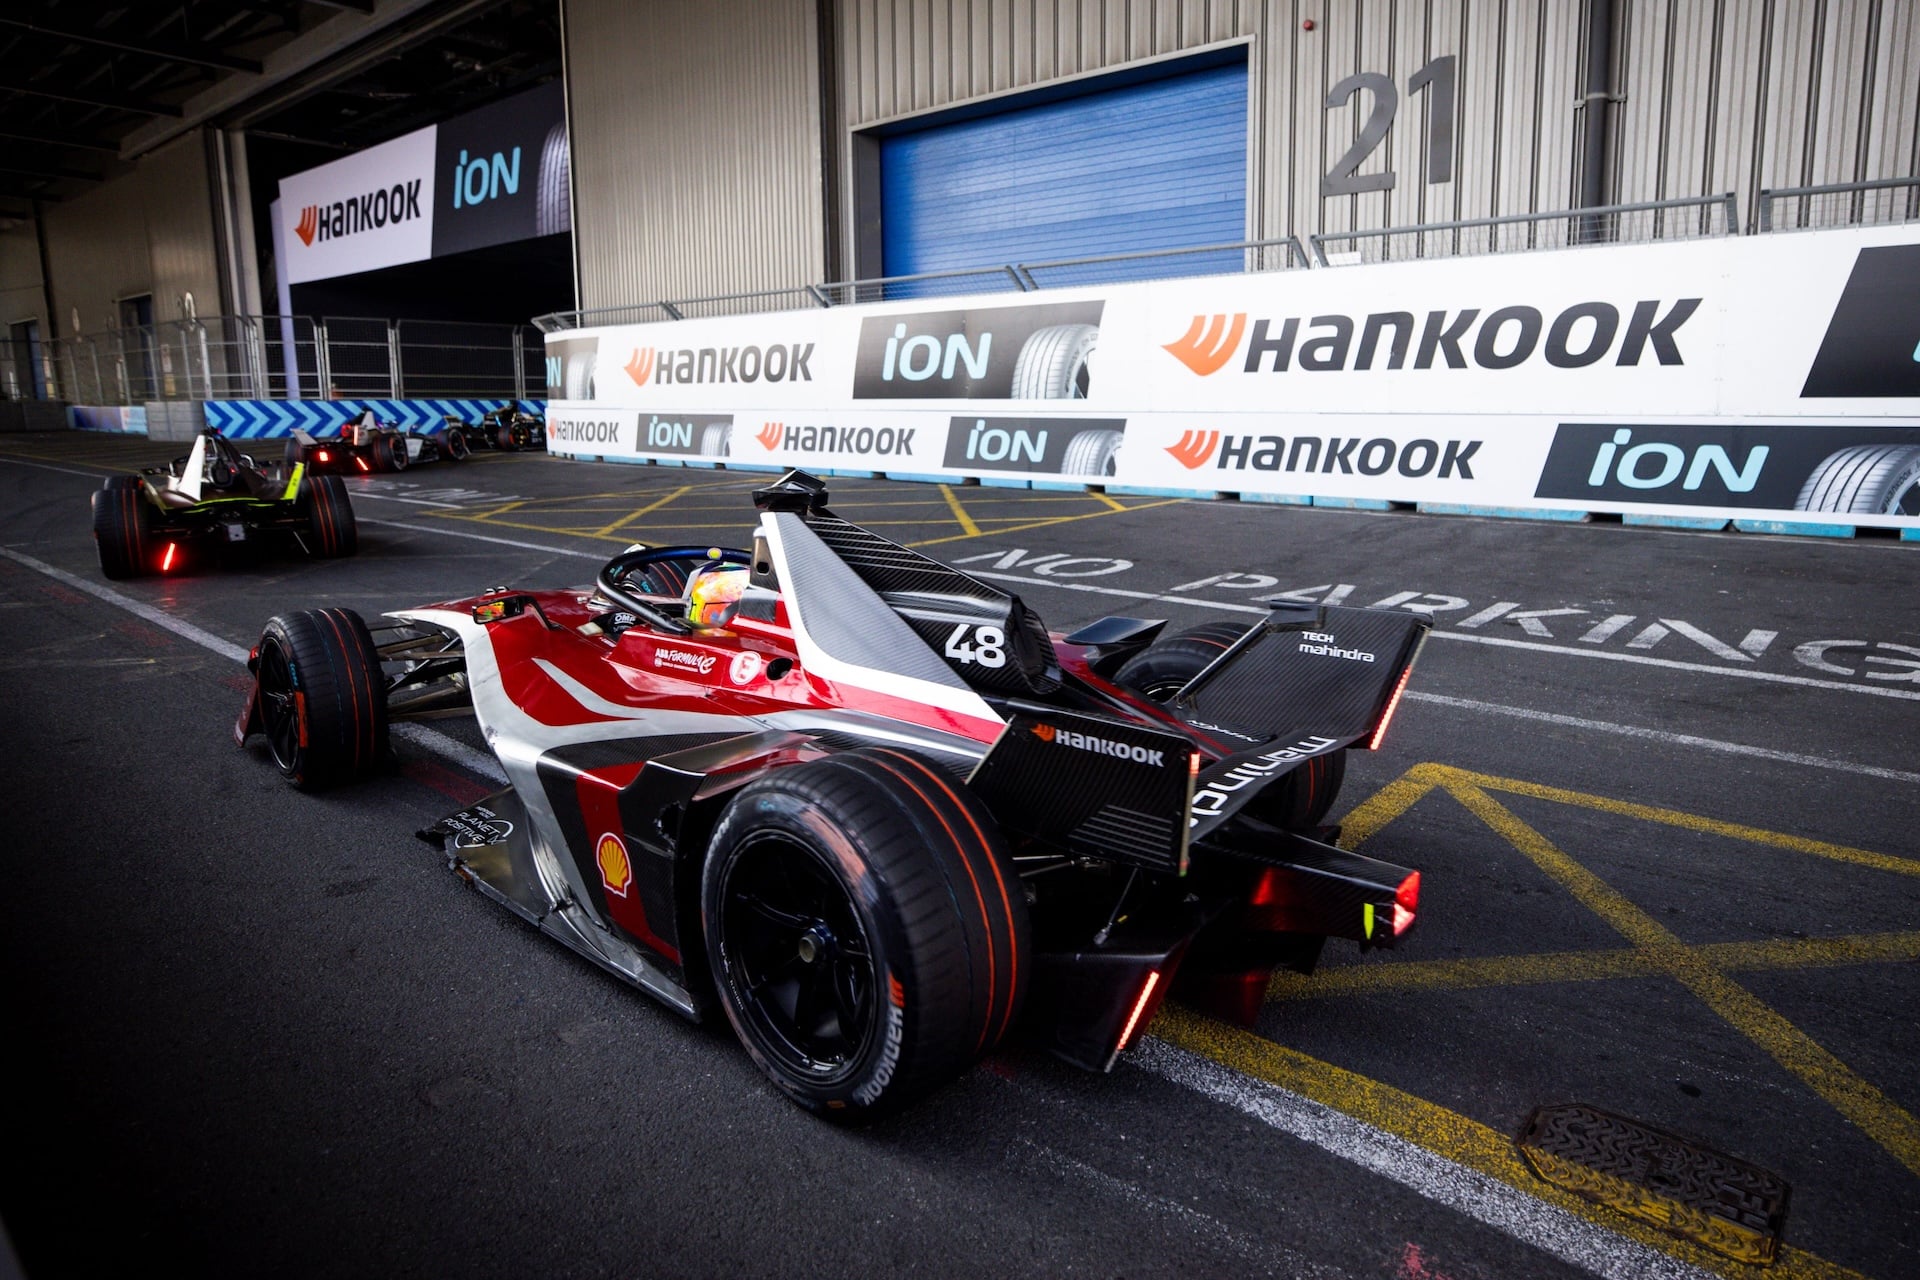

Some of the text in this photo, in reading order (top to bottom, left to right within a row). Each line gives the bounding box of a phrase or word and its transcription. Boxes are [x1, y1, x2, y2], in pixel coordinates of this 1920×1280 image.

[1321, 55, 1456, 197] 21
[454, 147, 521, 209] iON
[882, 323, 992, 381] iON
[648, 415, 693, 448] iON
[965, 419, 1048, 462] iON
[1588, 428, 1770, 493] iON
[951, 549, 1134, 577] NO
[945, 623, 1006, 668] 48
[1299, 643, 1375, 663] mahindra
[1302, 631, 1334, 643] TECH
[442, 818, 485, 842] POSITIVE
[456, 812, 501, 836] PLANET
